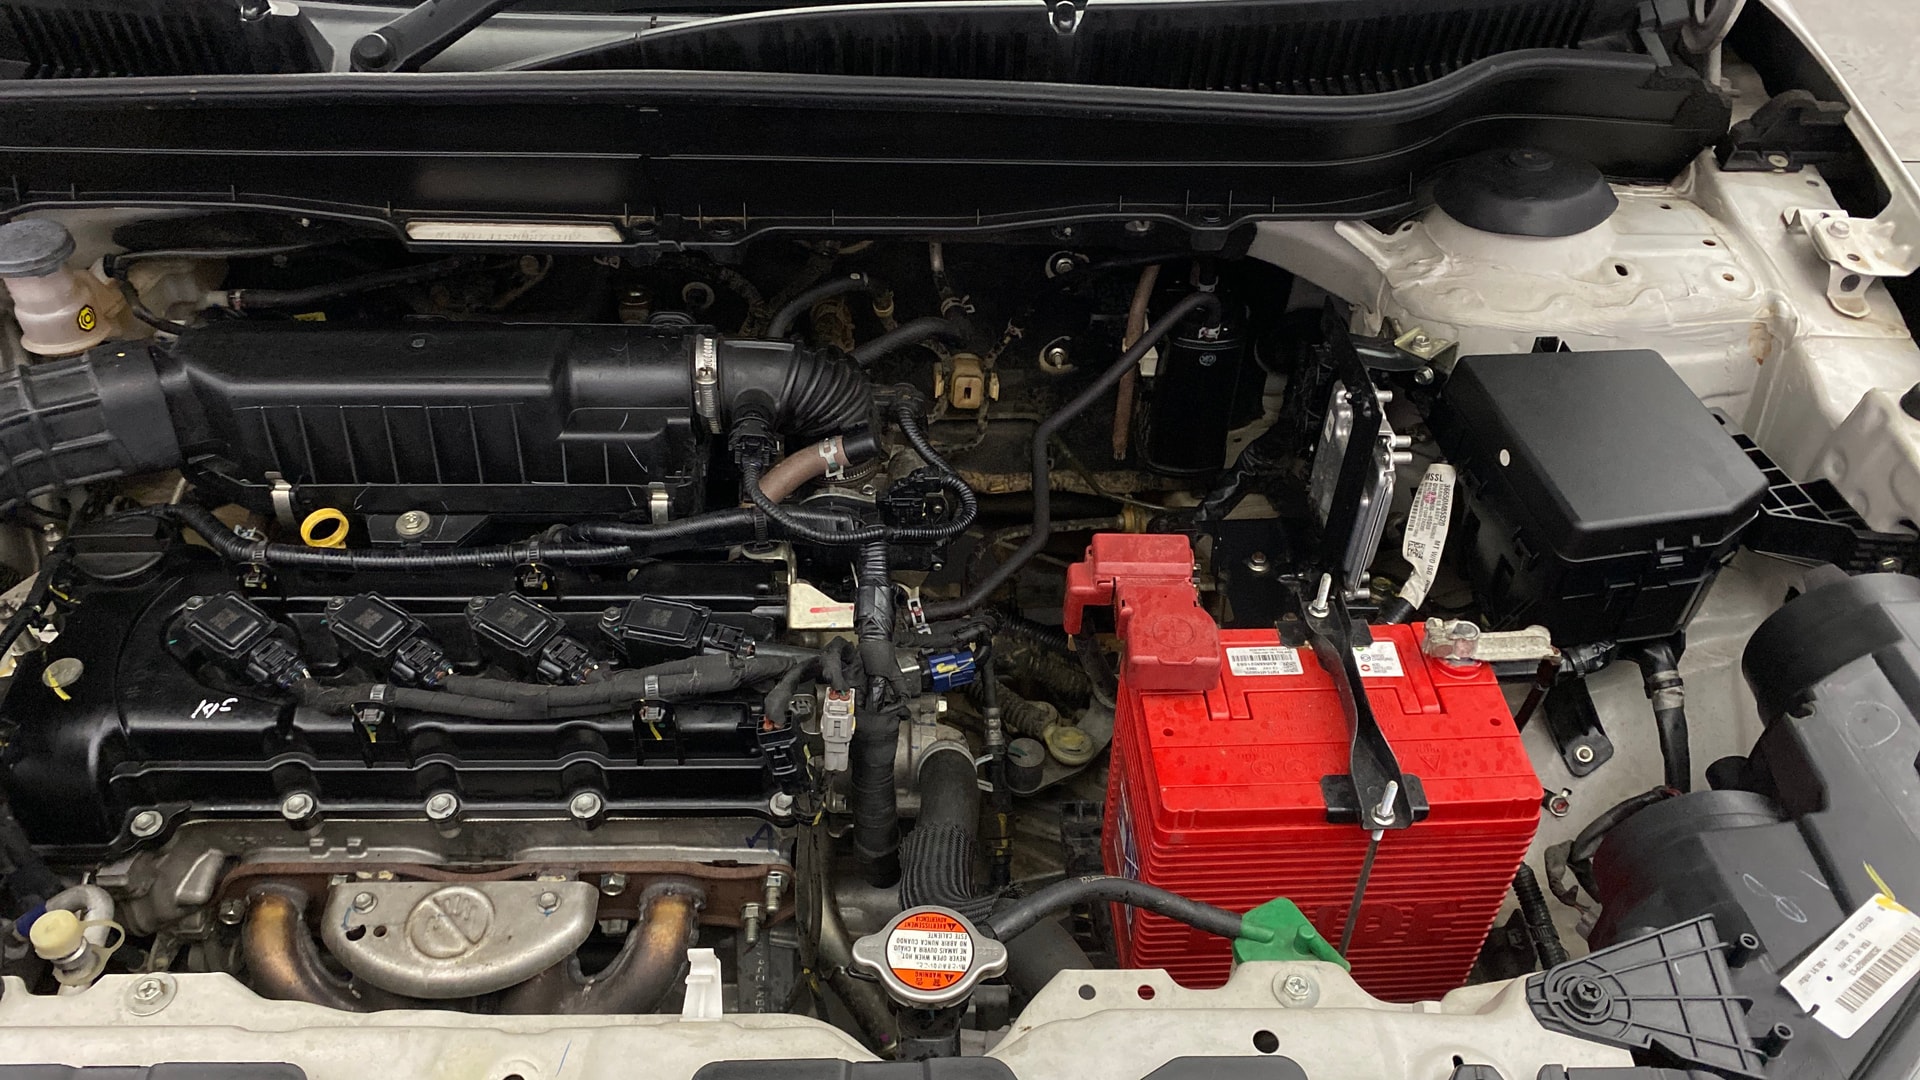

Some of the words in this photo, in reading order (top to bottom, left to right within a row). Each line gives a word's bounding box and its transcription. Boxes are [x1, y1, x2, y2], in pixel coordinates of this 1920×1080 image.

[1434, 540, 1441, 551] MT
[904, 921, 946, 929] AVERTISSEMENT
[896, 937, 918, 945] CUANDO
[949, 954, 967, 962] NEVER
